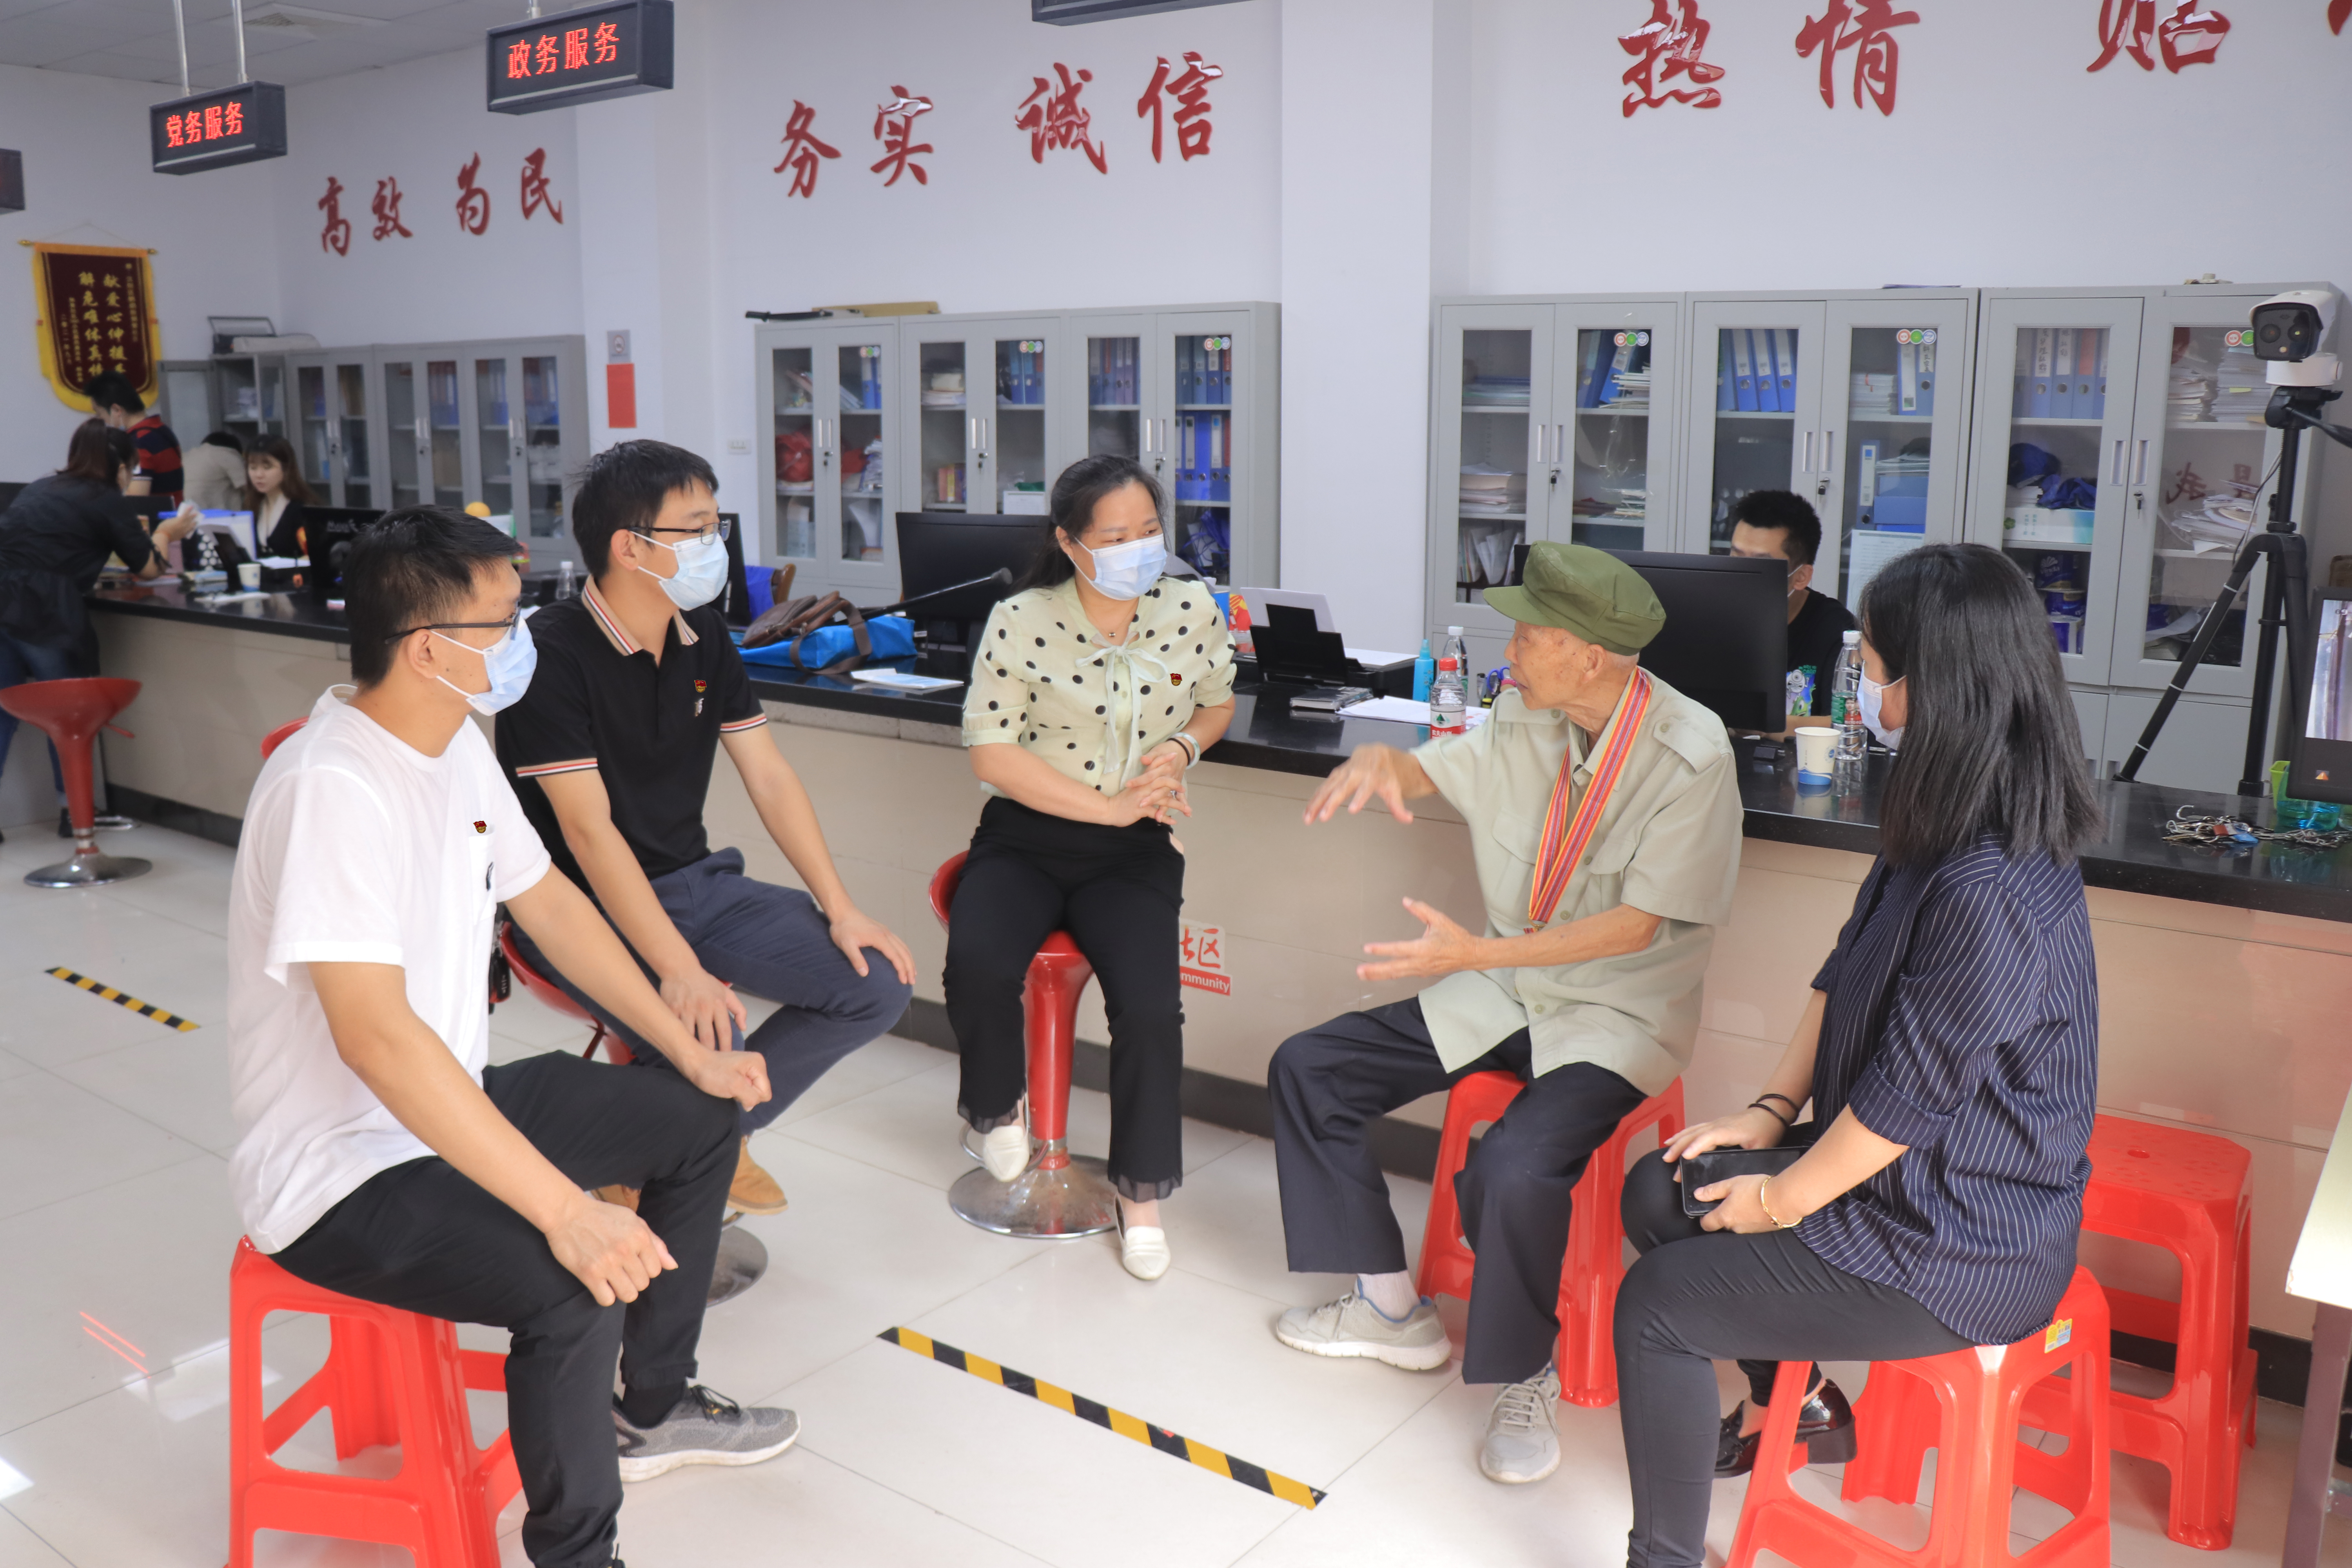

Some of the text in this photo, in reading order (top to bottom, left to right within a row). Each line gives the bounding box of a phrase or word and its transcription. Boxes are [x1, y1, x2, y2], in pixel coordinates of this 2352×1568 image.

[507, 22, 620, 79] 政务服务
[1617, 0, 1922, 118] 热情
[166, 102, 244, 149] 党务服务
[773, 51, 1224, 198] 务实 诚信
[318, 147, 564, 257] 高效 为民
[1181, 972, 1230, 993] mmunity
